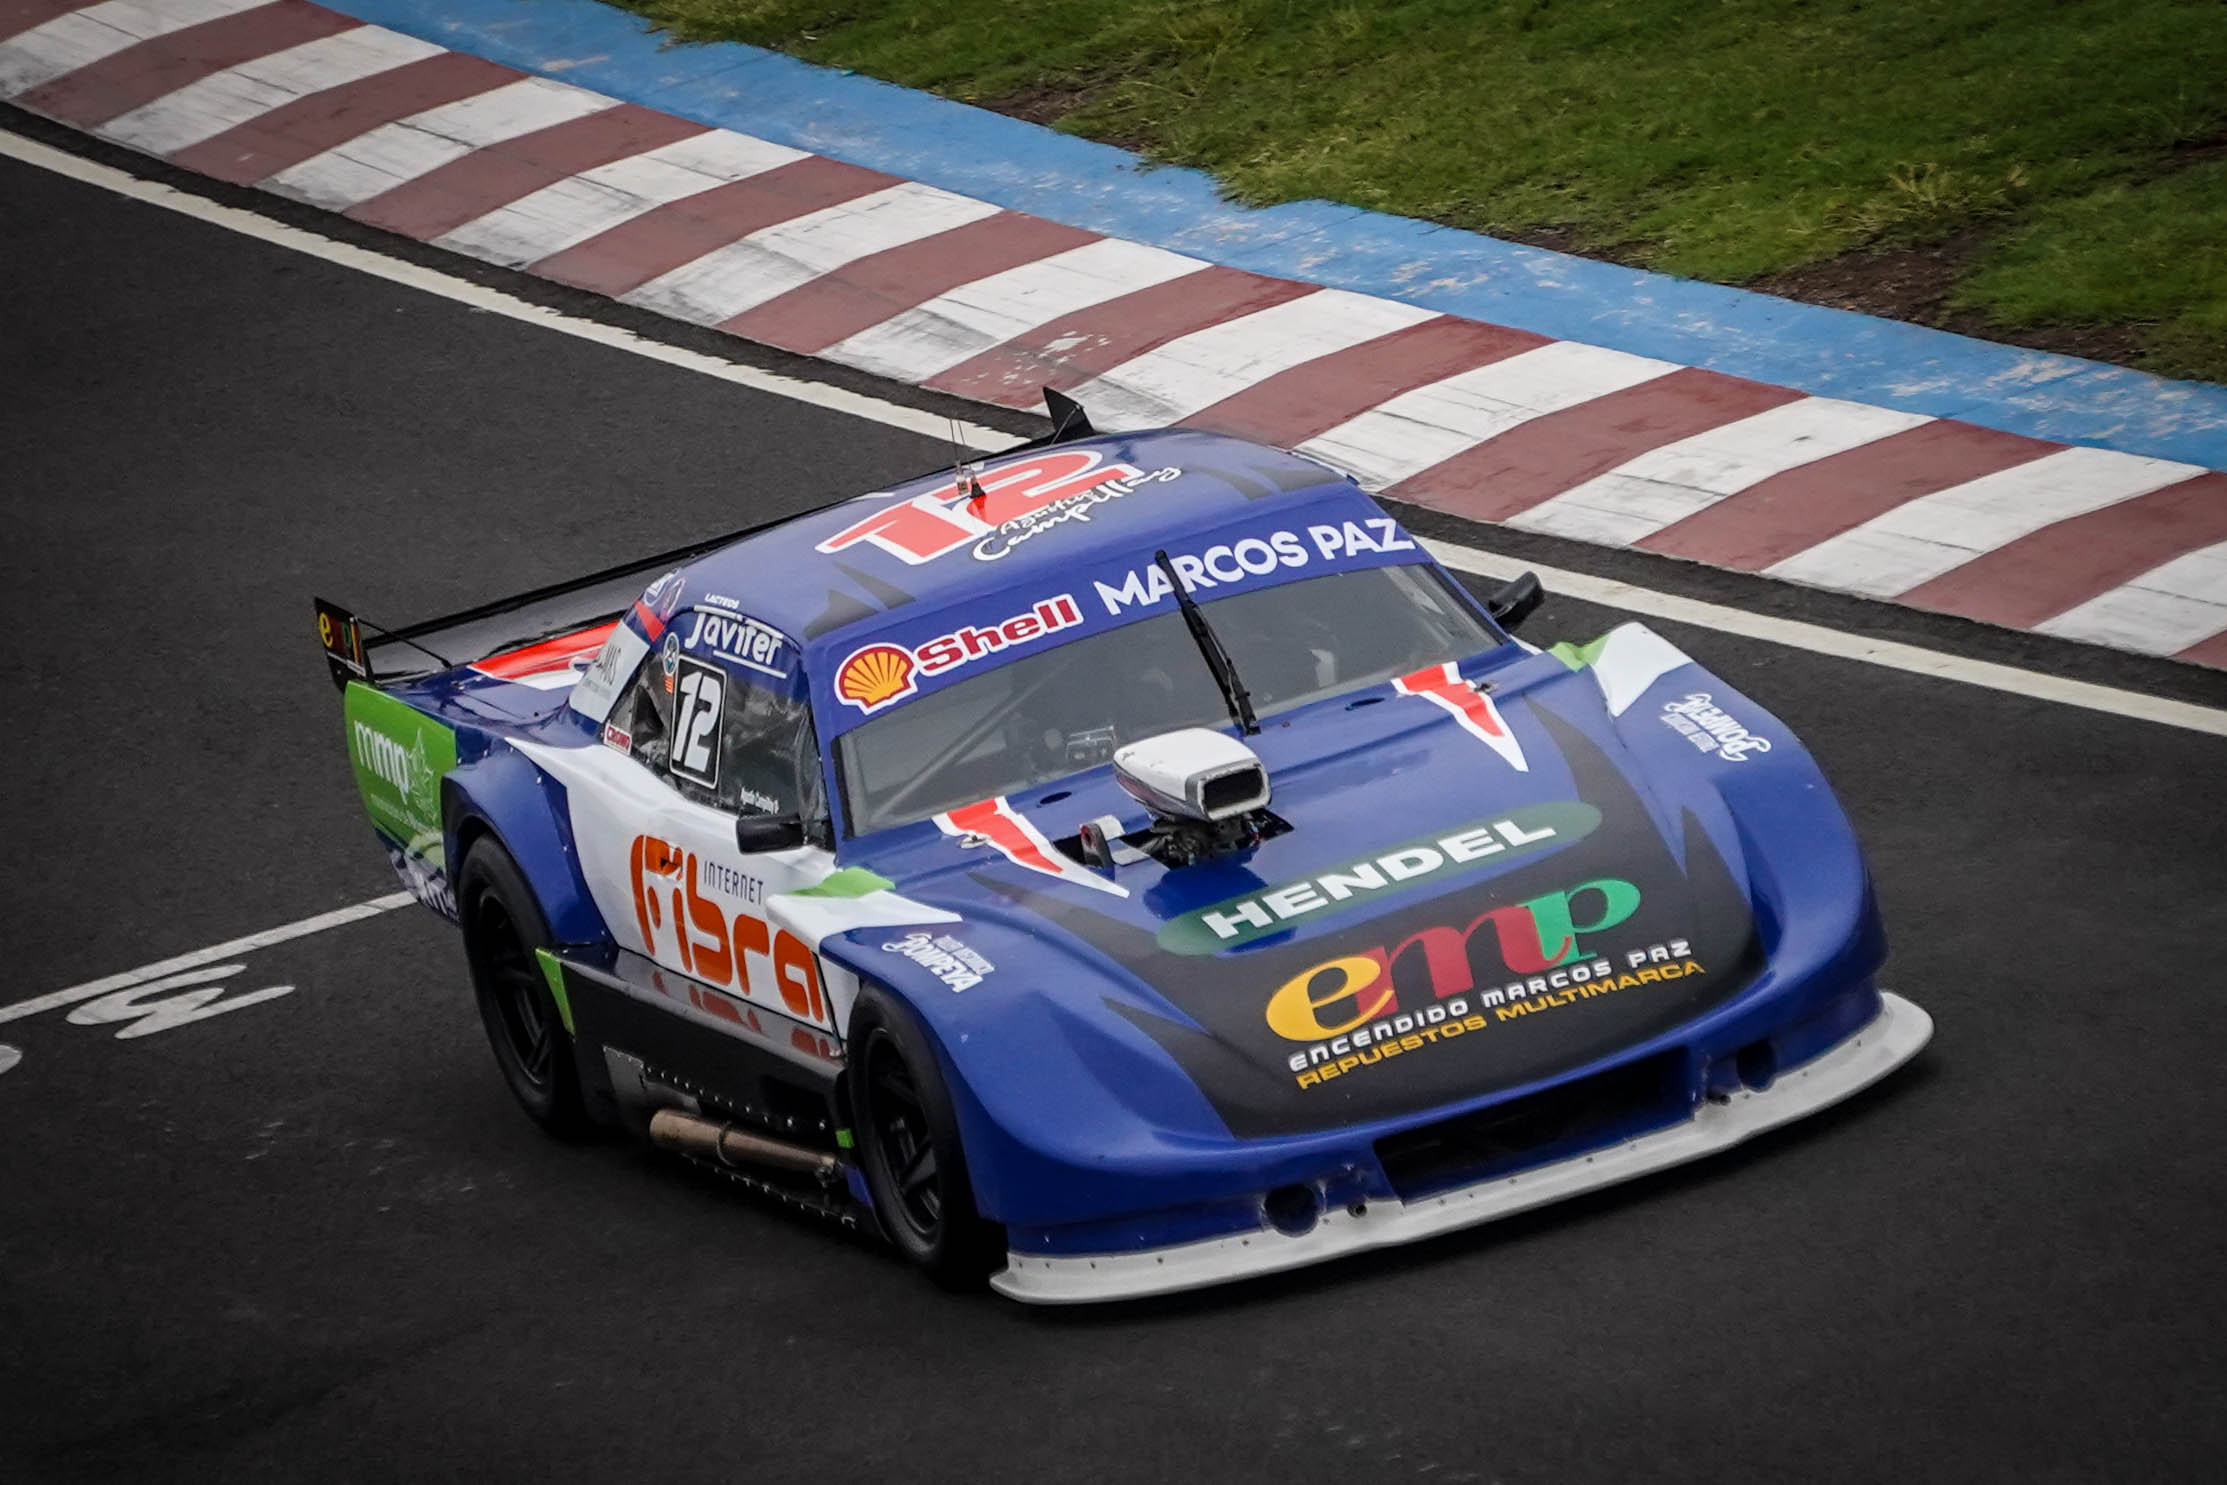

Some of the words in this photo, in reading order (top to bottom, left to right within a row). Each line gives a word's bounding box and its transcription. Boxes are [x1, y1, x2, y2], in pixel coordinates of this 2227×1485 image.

[815, 451, 1145, 566] 12
[1093, 531, 1308, 616] MARCOS
[1306, 518, 1415, 560] PAZ
[916, 595, 1080, 675] Shell
[672, 671, 722, 773] 12
[704, 860, 765, 905] INTERNET
[1202, 818, 1557, 940] HENDEL
[1265, 877, 1642, 1042] emp
[1627, 940, 1692, 969] PAZ
[1296, 1014, 1488, 1090] REPUESTOS
[1495, 960, 1706, 1022] MULTIMARCA
